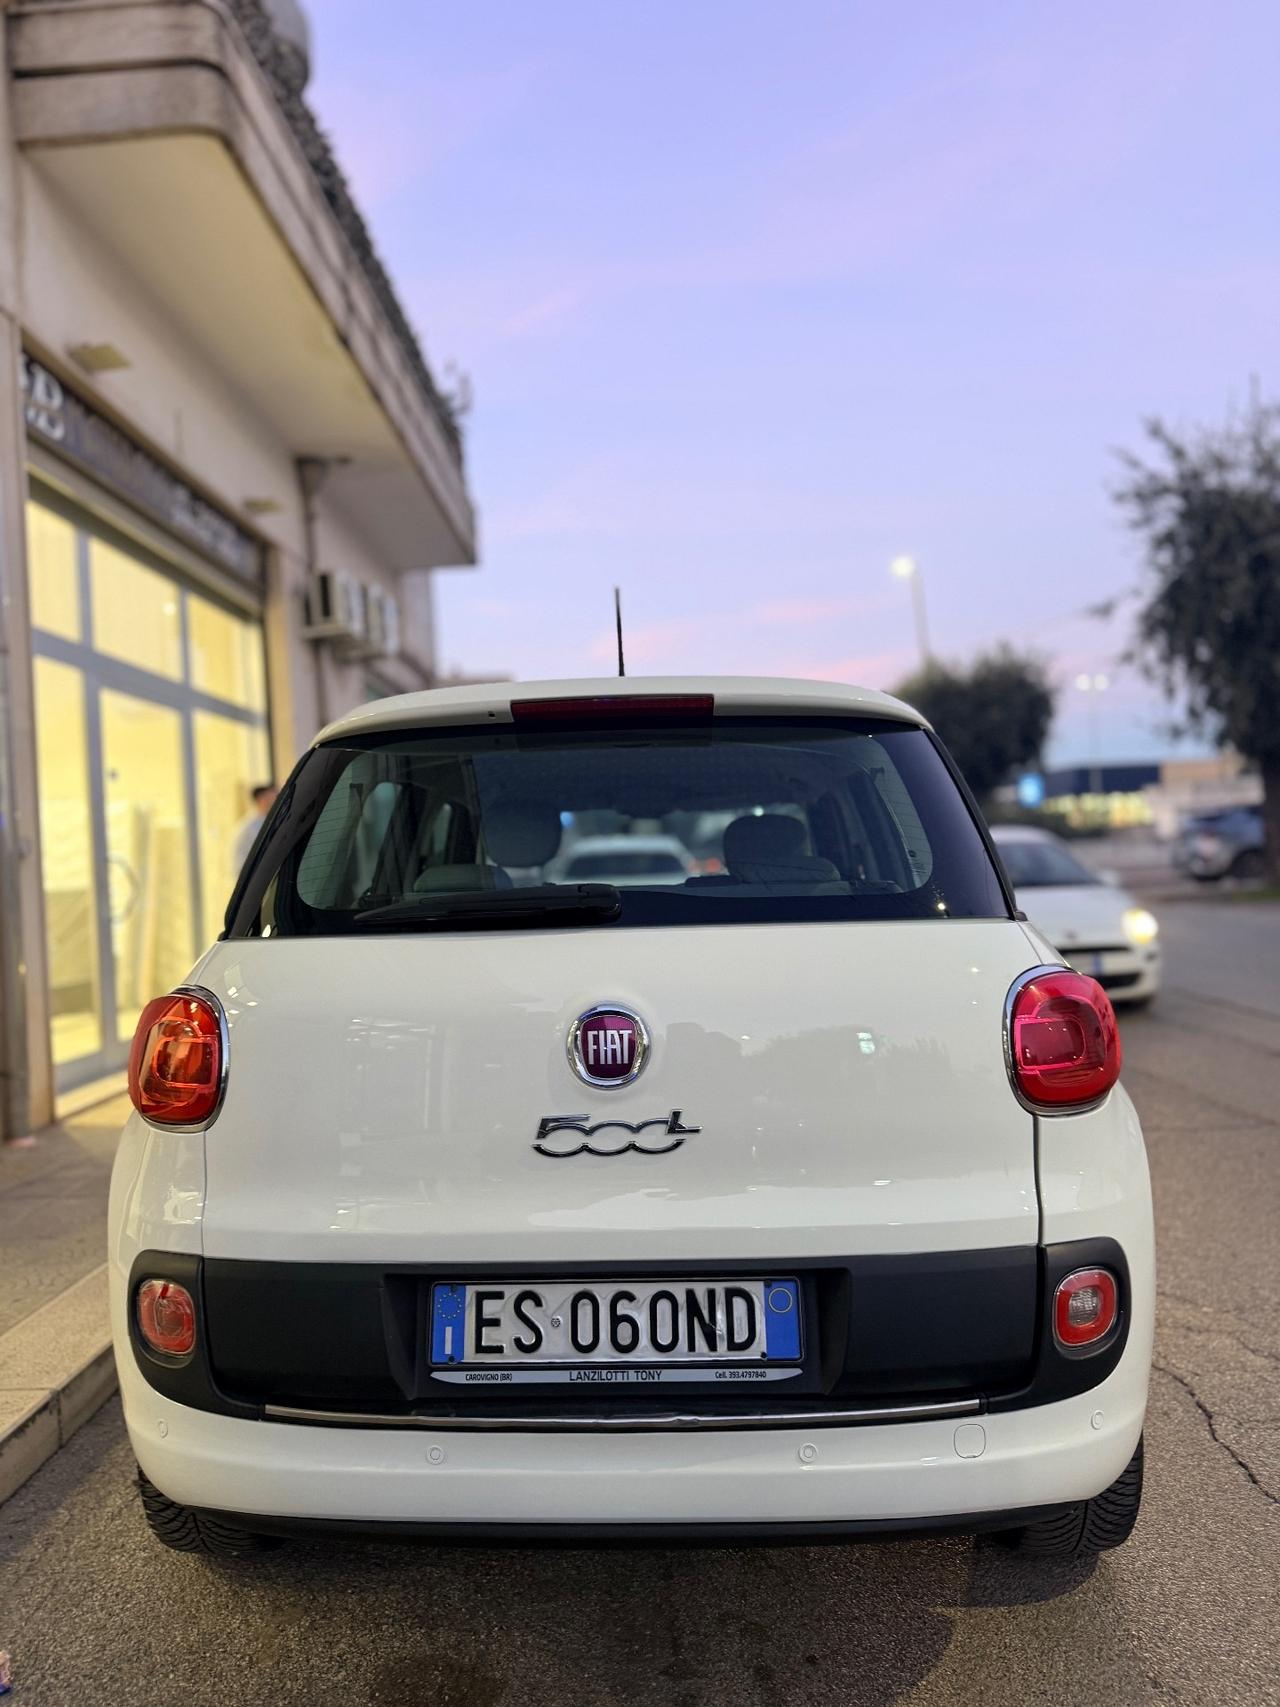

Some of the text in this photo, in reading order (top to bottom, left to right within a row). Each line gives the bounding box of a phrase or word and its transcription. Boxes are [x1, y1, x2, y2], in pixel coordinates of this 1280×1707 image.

[587, 1029, 632, 1065] FIAT
[532, 1108, 703, 1157] 500L
[444, 1326, 453, 1355] I
[465, 1373, 513, 1382] CAROVIGNO (BR)
[569, 1370, 662, 1381] LANZILOTTI TONY
[714, 1370, 767, 1379] Cell. 393.4797840
